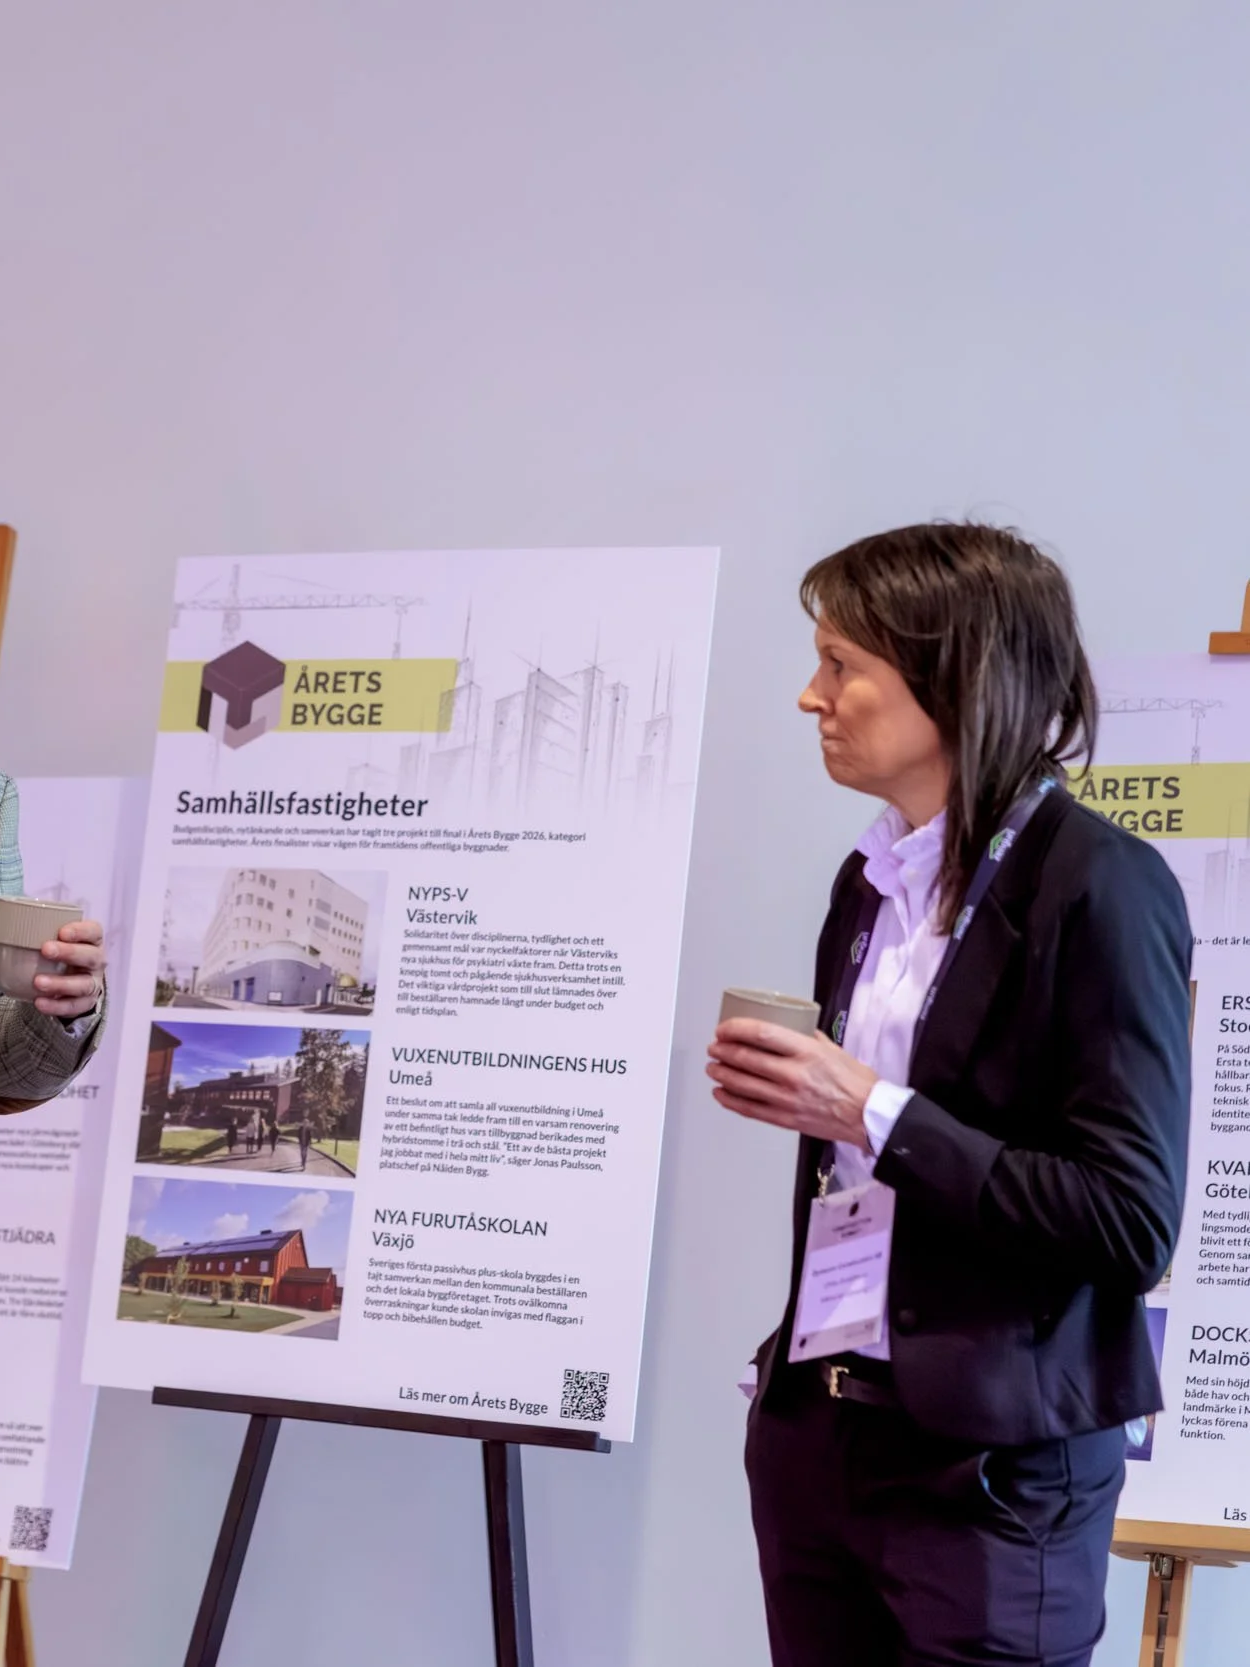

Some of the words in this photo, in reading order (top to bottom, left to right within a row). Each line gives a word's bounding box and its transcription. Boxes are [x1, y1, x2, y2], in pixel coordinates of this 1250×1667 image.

[294, 665, 382, 693] ÅRETS
[291, 704, 383, 726] BYGGE
[176, 790, 428, 820] Samhällsfastigheter
[468, 827, 491, 838] Årets
[492, 830, 520, 842] Bygge
[548, 831, 586, 842] kategori
[408, 886, 469, 901] NYPS-V
[406, 908, 477, 925] Västervik
[404, 929, 448, 940] Solidaritet
[450, 930, 469, 940] över
[531, 933, 571, 946] tydlighet
[572, 935, 589, 945] och
[590, 936, 604, 945] ett
[486, 945, 551, 957] nyckelfaktorer
[553, 948, 568, 957] när
[570, 948, 618, 959] Västerviks
[506, 958, 532, 968] växte
[558, 960, 584, 970] Detta
[586, 961, 608, 972] trots
[469, 969, 512, 982] pågående
[513, 971, 600, 984] sjukhusverksamhet
[447, 981, 498, 994] vårdprojekt
[520, 984, 532, 994] till
[534, 985, 550, 994] slut
[551, 985, 595, 996] lämnades
[596, 987, 616, 997] över
[395, 1004, 420, 1017] enligt
[525, 998, 551, 1008] under
[553, 998, 586, 1012] budget
[587, 1001, 604, 1010] och
[1217, 1044, 1229, 1053] På
[392, 1047, 587, 1072] VUXENUTBILDNINGENS
[591, 1059, 627, 1074] HUS
[1216, 1057, 1241, 1066] Ersta
[389, 1070, 433, 1086] Umeå
[1214, 1083, 1243, 1092] fokus.
[1213, 1096, 1249, 1105] teknisk
[458, 1100, 484, 1110] samla
[498, 1104, 570, 1118] vuxenutbildning
[576, 1106, 604, 1117] Umeå
[443, 1112, 458, 1122] tak
[459, 1112, 484, 1123] ledde
[485, 1114, 507, 1124] fram
[508, 1115, 521, 1125] till
[535, 1120, 568, 1128] varsam
[569, 1121, 619, 1134] renovering
[450, 1125, 466, 1135] hus
[467, 1129, 486, 1137] vars
[538, 1131, 583, 1142] berikades
[585, 1134, 605, 1144] med
[449, 1151, 468, 1161] hela
[469, 1152, 488, 1162] mitt
[507, 1155, 531, 1167] säger
[534, 1156, 559, 1167] Jonas
[533, 1144, 545, 1153] de
[546, 1144, 571, 1155] bästa
[573, 1147, 606, 1159] projekt
[420, 1162, 431, 1174] på
[1202, 1210, 1225, 1219] Med
[374, 1209, 407, 1226] NYA
[412, 1212, 548, 1236] FURUTÅSKOLAN
[372, 1232, 414, 1251] Växjö
[1200, 1236, 1225, 1246] blivit
[1227, 1238, 1241, 1246] ett
[1199, 1249, 1235, 1259] Genom
[406, 1261, 432, 1271] första
[433, 1264, 476, 1275] passivhus
[478, 1267, 523, 1279] plus-skola
[524, 1271, 562, 1283] byggdes
[1198, 1262, 1230, 1272] arbete
[464, 1279, 481, 1288] den
[482, 1280, 534, 1293] kommunala
[536, 1285, 587, 1297] beställaren
[1196, 1276, 1214, 1285] och
[494, 1295, 516, 1305] Trots
[518, 1298, 568, 1310] ovälkomna
[384, 1312, 400, 1320] och
[402, 1312, 448, 1324] bibehållen
[431, 1302, 459, 1313] kunde
[460, 1306, 489, 1316] skolan
[490, 1308, 522, 1320] invigas
[523, 1312, 543, 1320] med
[545, 1313, 578, 1326] flaggan
[1189, 1348, 1250, 1366] Malmö
[1186, 1376, 1208, 1386] Med
[1211, 1378, 1225, 1387] sin
[1228, 1378, 1250, 1389] höjd
[399, 1387, 419, 1400] Läs
[422, 1393, 445, 1402] mer
[449, 1396, 469, 1404] om
[471, 1392, 506, 1408] Årets
[509, 1398, 548, 1415] Bygge
[1185, 1388, 1209, 1399] både
[1211, 1390, 1229, 1400] hav
[1232, 1392, 1250, 1401] och
[1183, 1402, 1236, 1414] landmärke
[1182, 1415, 1213, 1426] lyckas
[1215, 1417, 1248, 1428] förena
[1180, 1429, 1226, 1440] funktion.
[1224, 1507, 1246, 1521] Läs
